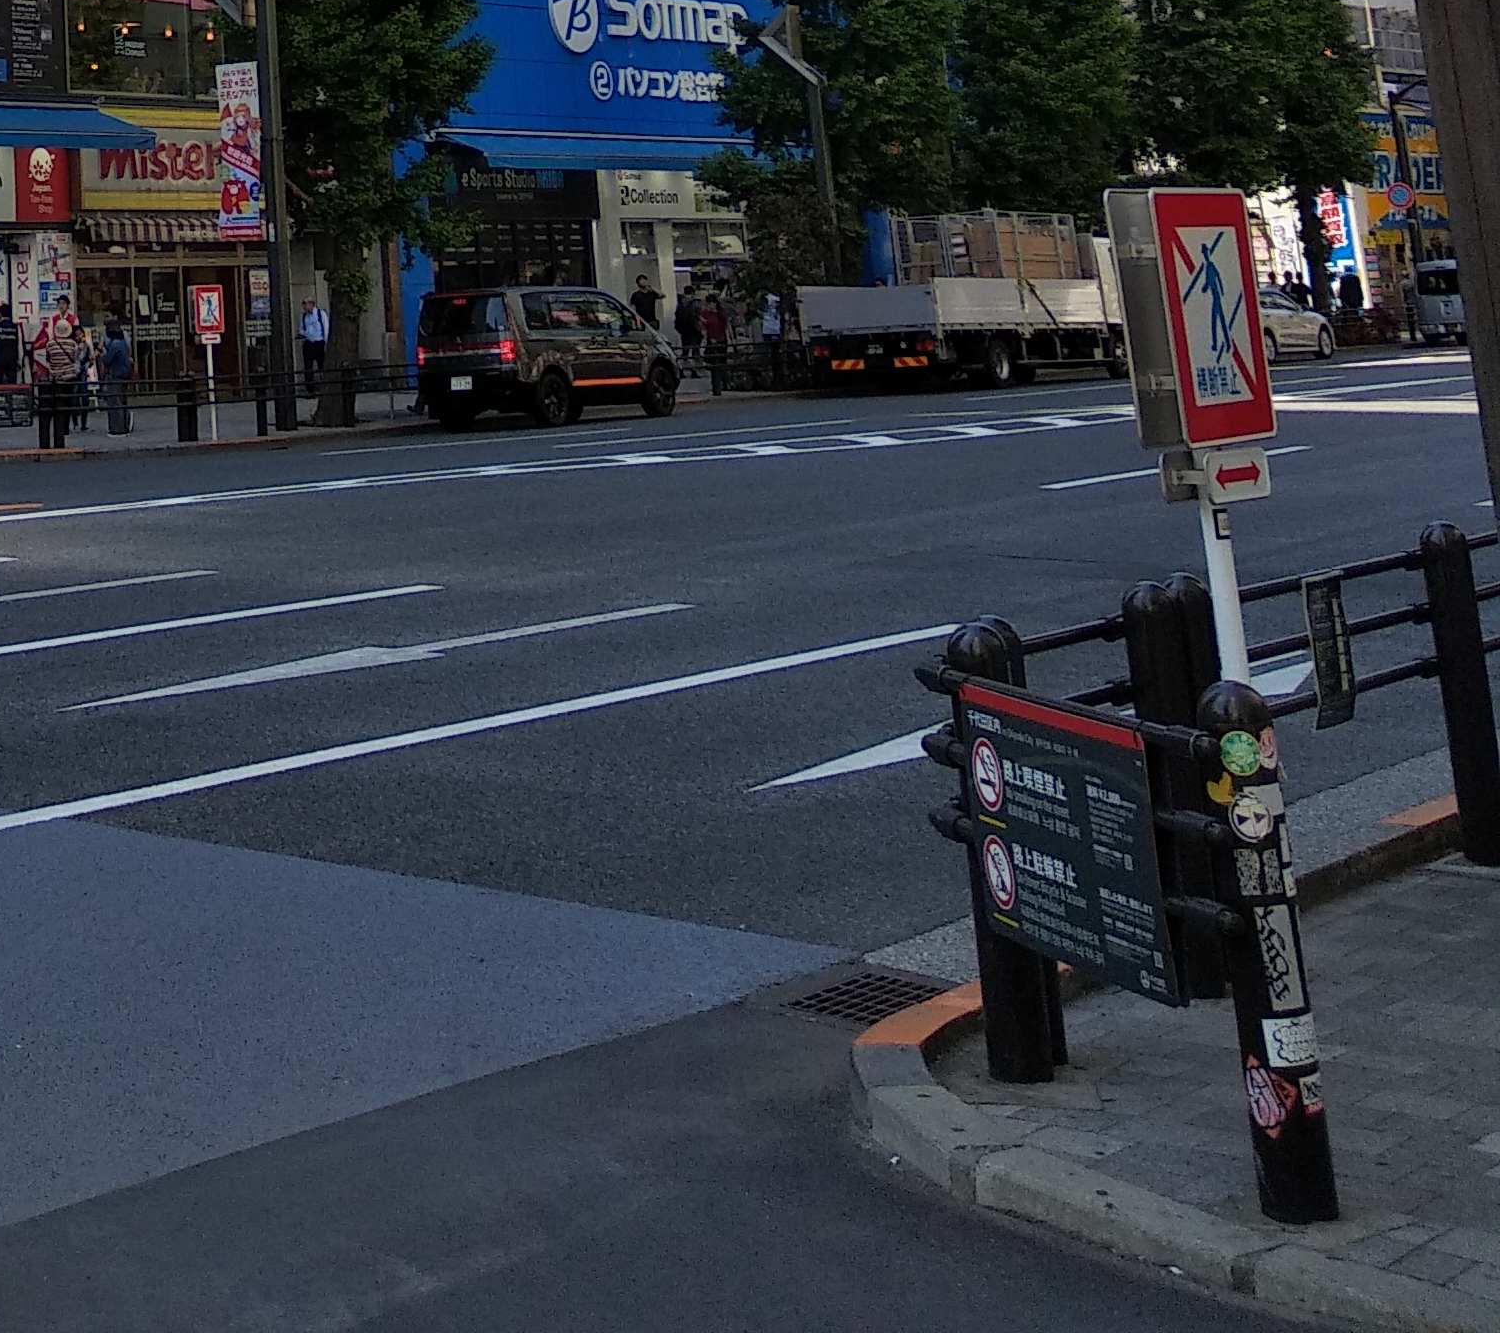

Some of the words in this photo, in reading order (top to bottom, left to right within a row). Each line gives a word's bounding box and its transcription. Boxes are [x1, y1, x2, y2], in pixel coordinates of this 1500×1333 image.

[469, 167, 504, 192] Sports
[505, 169, 536, 190] Studio
[631, 188, 680, 205] Collection
[17, 243, 31, 290] Tax
[1002, 757, 1069, 802] 路上喫煙禁止
[1011, 841, 1079, 889] 路上駐輪禁止
